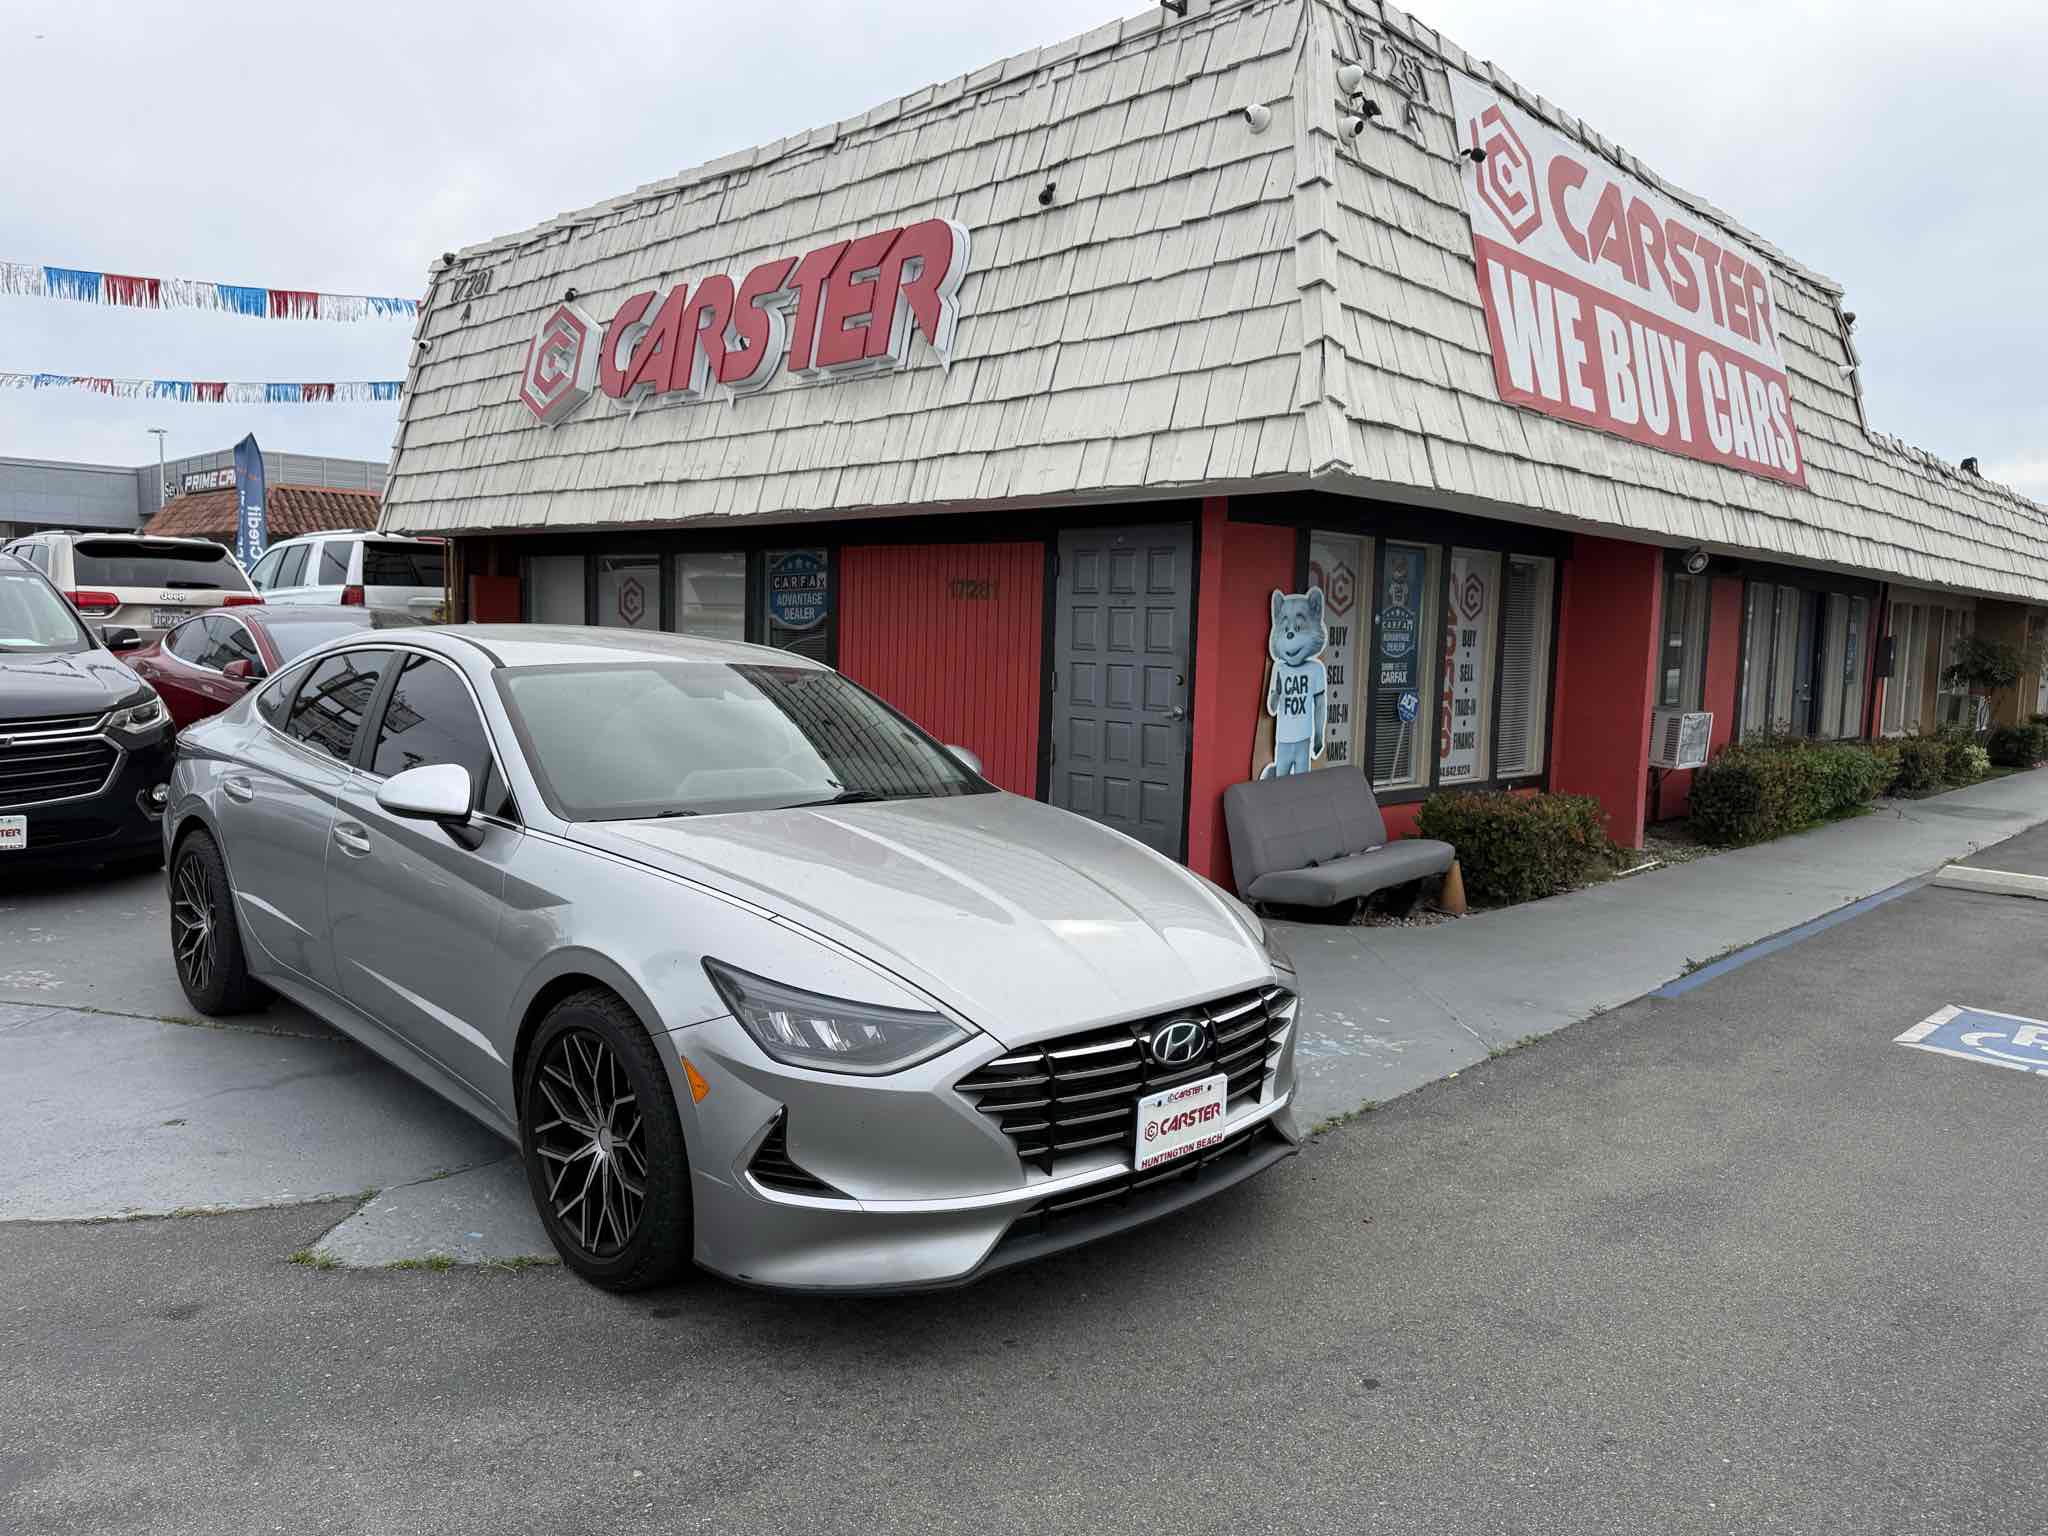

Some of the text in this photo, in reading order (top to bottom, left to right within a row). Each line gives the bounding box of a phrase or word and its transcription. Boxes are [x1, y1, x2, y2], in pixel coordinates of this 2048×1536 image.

[1344, 22, 1430, 102] 17281
[1548, 155, 1776, 348] CARSTER
[451, 268, 494, 304] 17281
[600, 218, 970, 402] CARSTER
[1487, 258, 1798, 475] WE BUY CARS
[184, 471, 218, 493] PRIME
[160, 591, 186, 601] Jeep
[776, 592, 824, 607] ADVANTAGE
[784, 606, 816, 620] DEALER
[1329, 626, 1348, 646] BUY
[1462, 629, 1477, 647] BUY
[1327, 665, 1345, 685] SELL
[1381, 671, 1408, 685] CARFAX
[1459, 663, 1474, 682] SELL
[1284, 674, 1309, 695] CAR
[1284, 694, 1307, 715] FOX
[1327, 703, 1349, 724] ADE-IN
[1326, 741, 1347, 761] NANCE
[1175, 1084, 1203, 1101] CARSTER
[1160, 1102, 1221, 1136] CARSTER
[1141, 1132, 1223, 1169] HUNTINGTON BEACH
